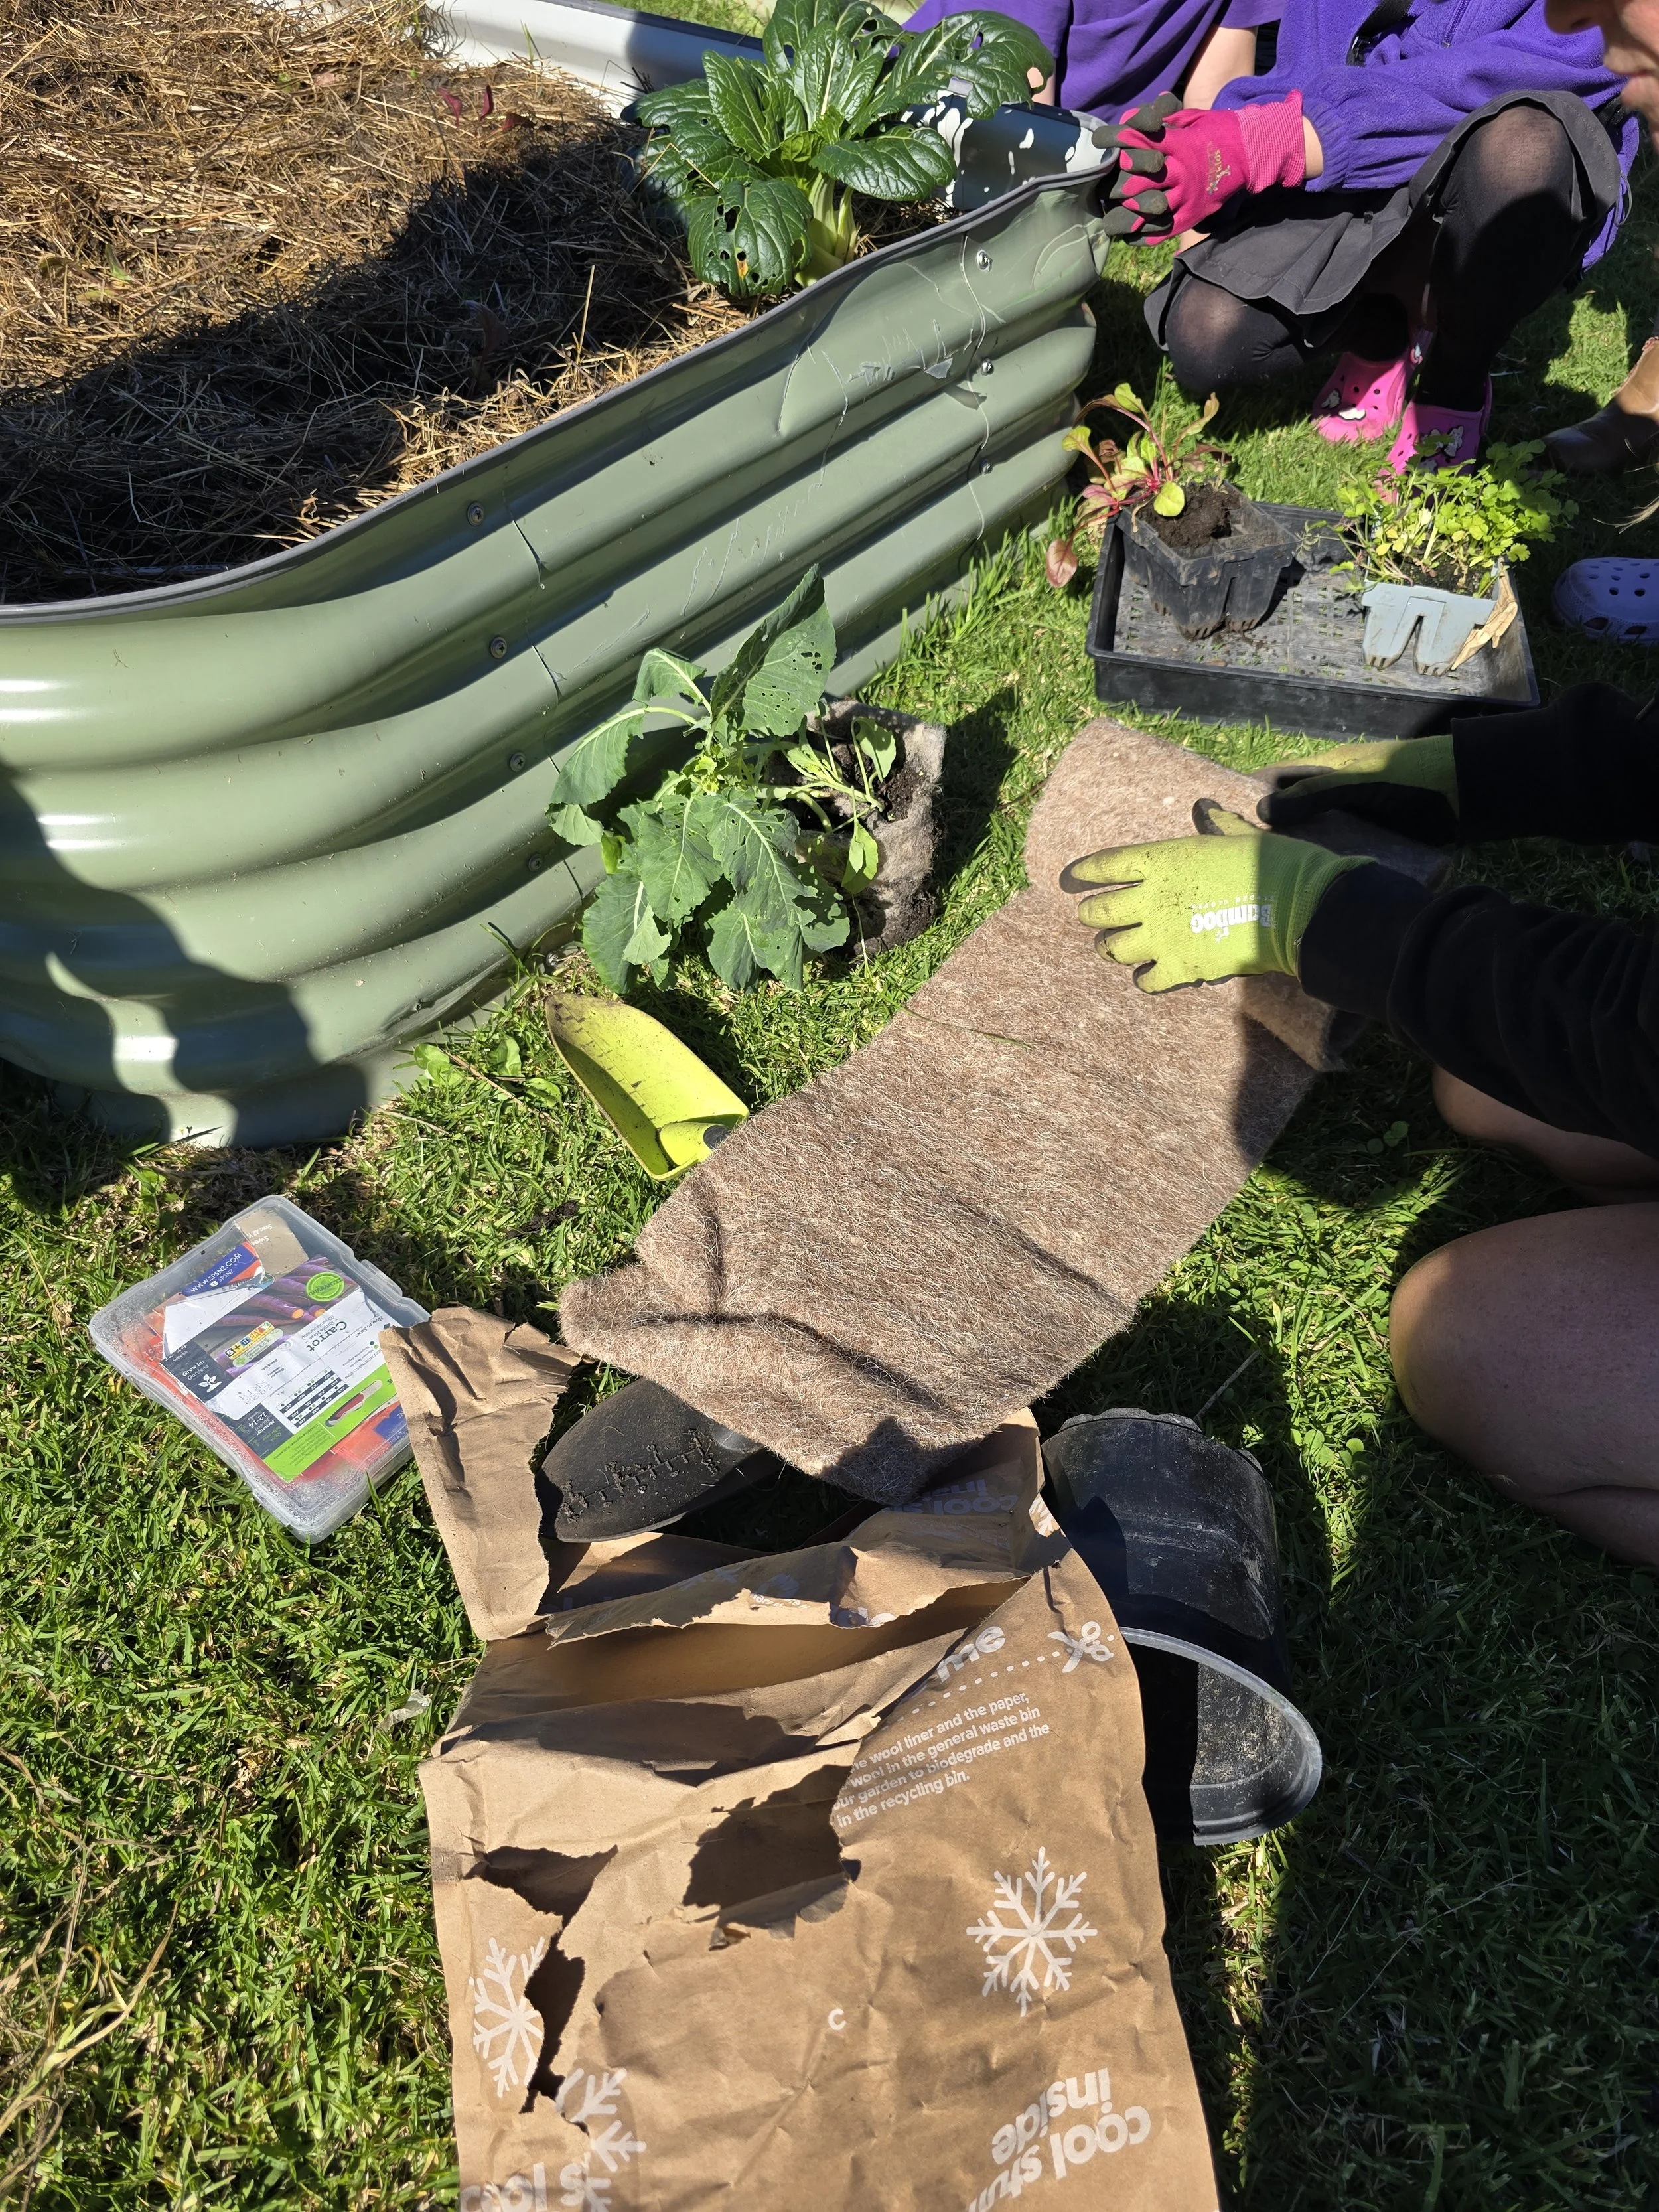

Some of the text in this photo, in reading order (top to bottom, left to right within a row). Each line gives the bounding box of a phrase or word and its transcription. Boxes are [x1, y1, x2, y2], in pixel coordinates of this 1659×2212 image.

[305, 1319, 348, 1353] Carrot
[182, 1364, 197, 1376] Grow
[187, 1364, 209, 1380] Gardens
[248, 1411, 267, 1429] 12-14
[255, 1419, 275, 1436] Maturity:
[937, 1626, 1006, 1682] me
[850, 1766, 885, 1787] wool
[885, 1762, 900, 1773] in
[902, 1751, 926, 1767] the
[928, 1725, 978, 1758] general
[979, 1713, 1018, 1735] waste
[1019, 1706, 1041, 1722] bin
[869, 1741, 903, 1763] wool
[904, 1728, 934, 1749] liner
[936, 1713, 962, 1733] and
[964, 1706, 987, 1721] the
[989, 1692, 1029, 1715] paper,
[857, 1775, 907, 1803] garden
[908, 1769, 924, 1780] to
[926, 1739, 1001, 1774] biodegrade
[1003, 1728, 1027, 1747] and
[1029, 1724, 1050, 1739] the
[837, 1770, 970, 1828] in the recycling bin.
[991, 2068, 1113, 2166] inside
[1049, 2105, 1151, 2180] cool
